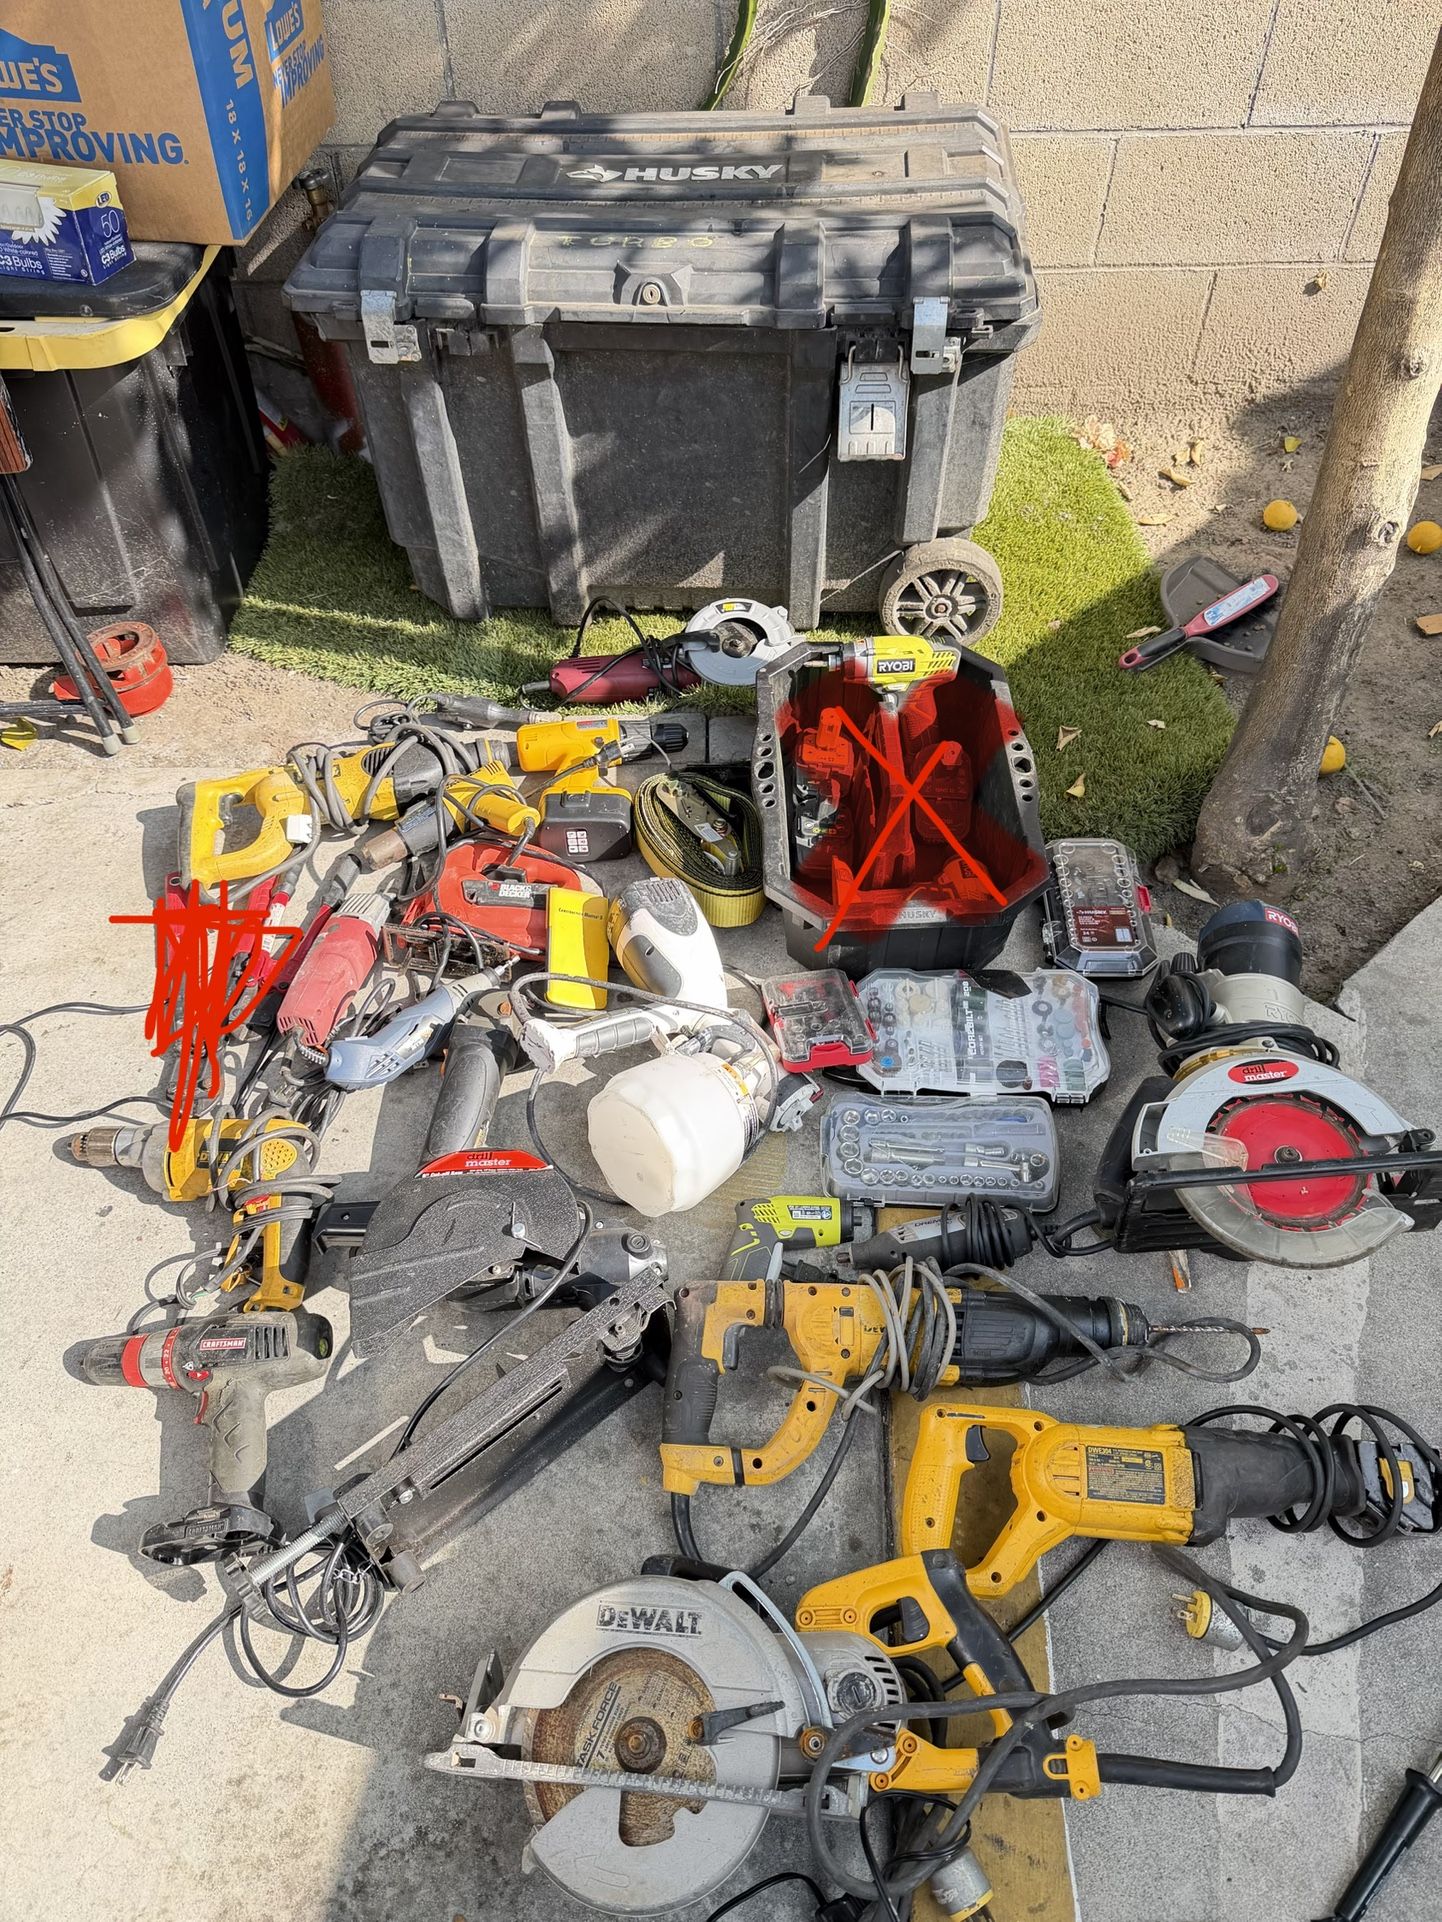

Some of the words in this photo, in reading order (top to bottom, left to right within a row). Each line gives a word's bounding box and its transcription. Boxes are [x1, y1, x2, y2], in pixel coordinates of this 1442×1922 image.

[269, 2, 300, 51] LOWE'S
[281, 33, 325, 109] IMPROVING
[29, 109, 87, 132] STOP
[225, 99, 237, 125] 18
[235, 149, 247, 174] 18
[623, 164, 784, 182] HUSKY
[100, 209, 120, 239] 50
[100, 252, 111, 265] C3
[109, 244, 126, 260] Bulbs
[12, 255, 43, 271] Bulbs
[877, 659, 915, 673] RYOBI
[499, 890, 531, 899] DECKER
[1242, 1062, 1266, 1075] drill
[1244, 1070, 1286, 1082] master
[464, 1158, 512, 1168] master
[466, 1151, 494, 1161] drill
[201, 1338, 244, 1349] CRAFTSMAN
[575, 1733, 596, 1767] TASK
[591, 1681, 618, 1730] FORCE
[596, 1750, 606, 1760] 7
